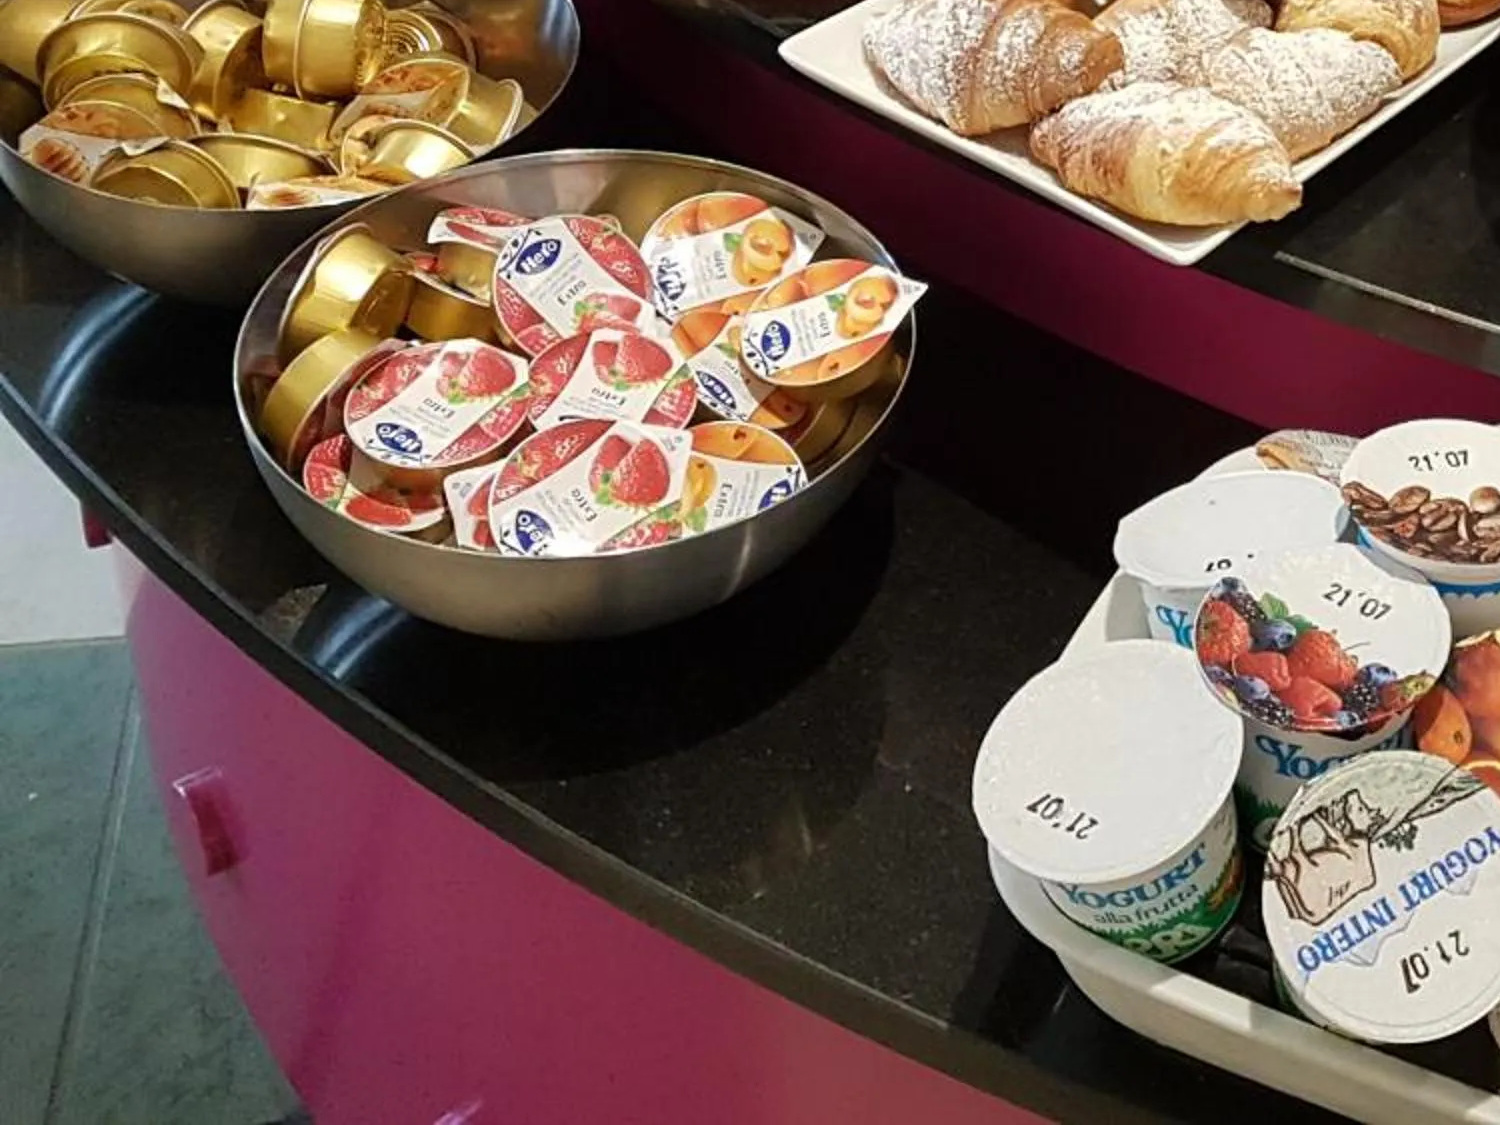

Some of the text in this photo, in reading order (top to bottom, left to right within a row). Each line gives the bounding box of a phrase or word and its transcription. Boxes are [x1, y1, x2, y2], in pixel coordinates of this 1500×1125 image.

[519, 239, 559, 273] Hero
[377, 424, 421, 453] Hero
[1296, 895, 1398, 973] INTERO
